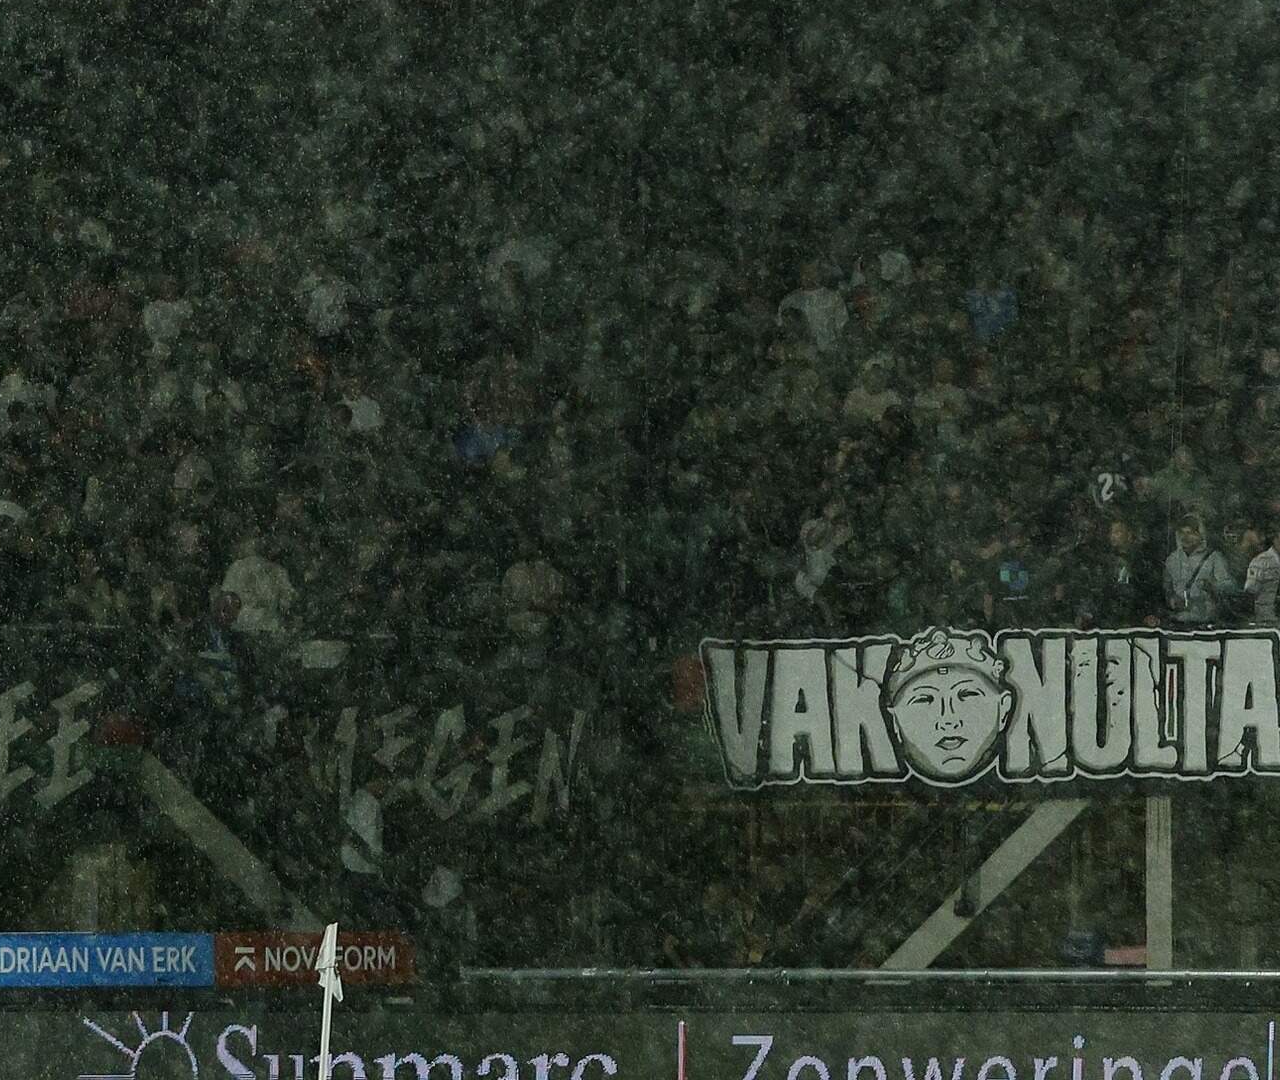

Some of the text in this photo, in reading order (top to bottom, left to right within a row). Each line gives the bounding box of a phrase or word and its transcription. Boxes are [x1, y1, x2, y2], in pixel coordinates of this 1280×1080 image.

[705, 638, 906, 784] VAK
[96, 947, 145, 973] VAN
[153, 946, 197, 972] ERK
[264, 947, 396, 972] NOVFORM
